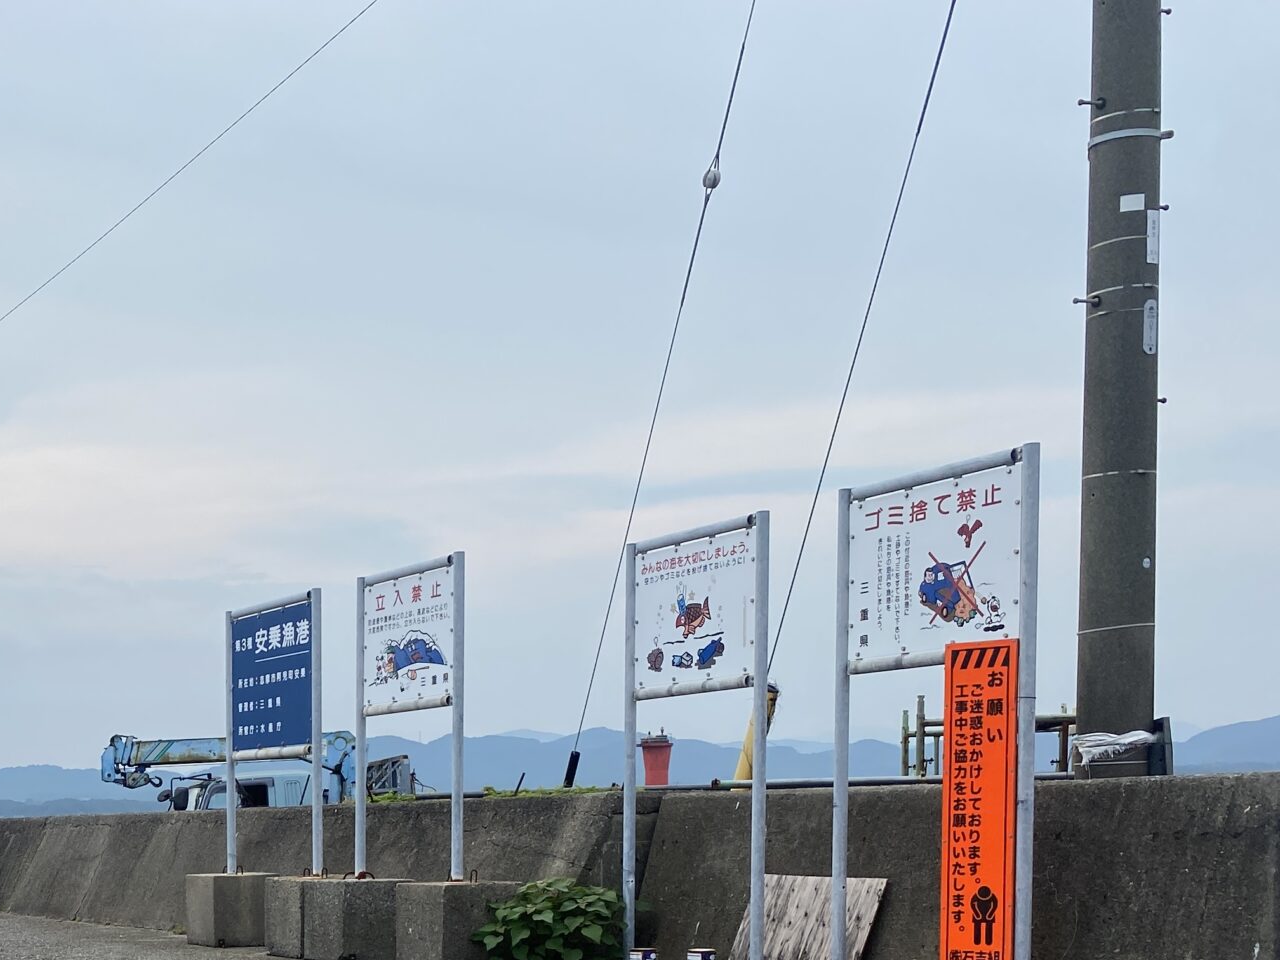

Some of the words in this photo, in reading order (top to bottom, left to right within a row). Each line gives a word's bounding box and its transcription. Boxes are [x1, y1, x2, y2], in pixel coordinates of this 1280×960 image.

[864, 483, 1002, 532] ゴミ捨て禁止
[375, 580, 442, 611] 立入禁止
[255, 618, 310, 654] 安乗漁港
[986, 671, 1004, 743] お願い
[951, 684, 969, 932] 工事中ご協力をお願いいたします。
[967, 684, 984, 884] ご迷惑おかけしております。
